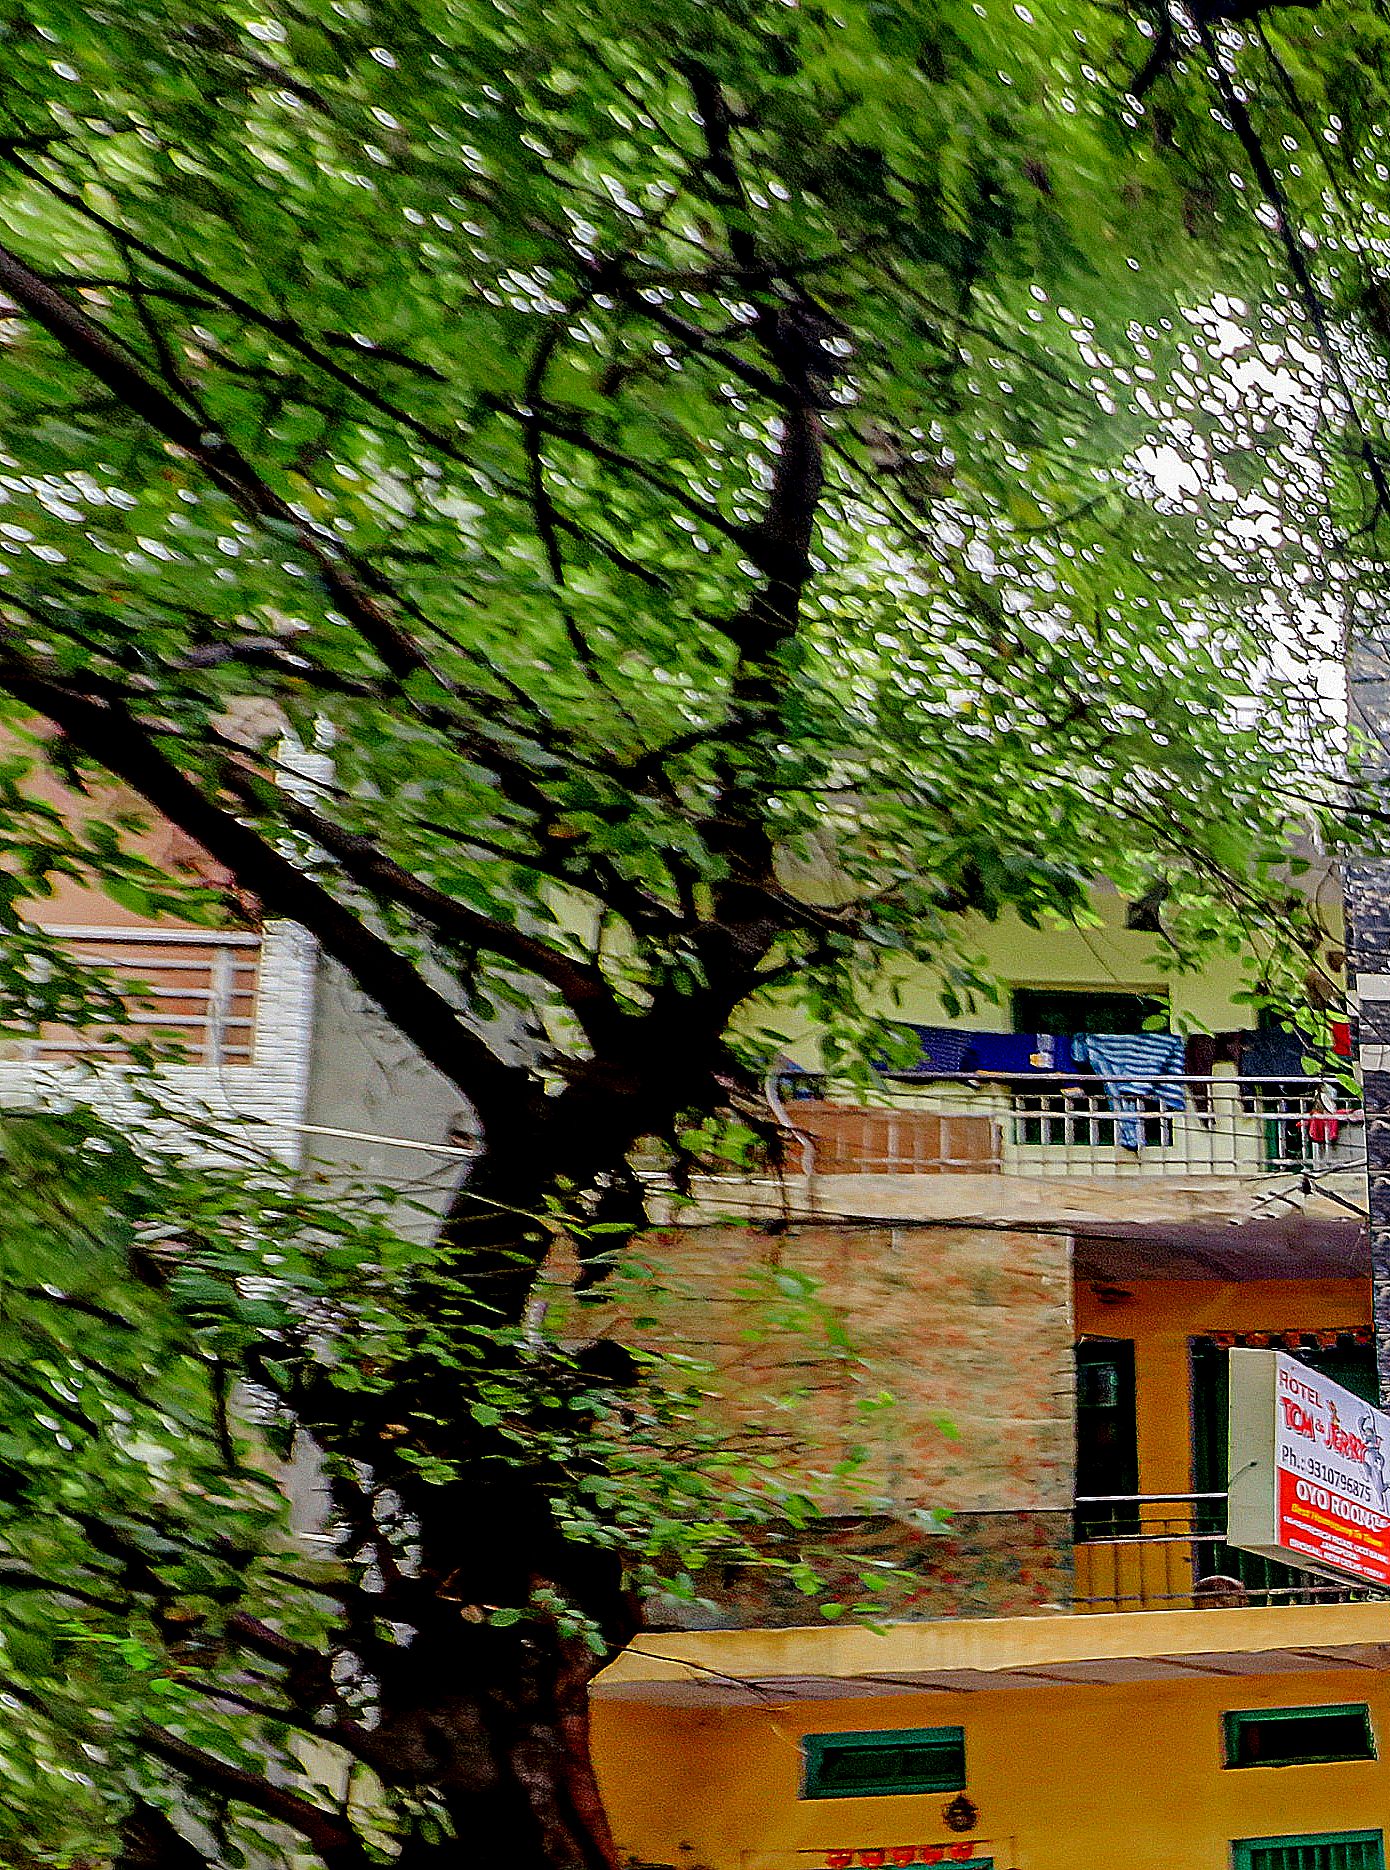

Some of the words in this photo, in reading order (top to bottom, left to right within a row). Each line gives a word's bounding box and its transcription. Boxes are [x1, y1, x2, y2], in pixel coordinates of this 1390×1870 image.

[1280, 1396, 1316, 1442] TOM
[1315, 1418, 1325, 1434] &
[1323, 1423, 1367, 1464] JERRY
[1296, 1480, 1330, 1510] OYO
